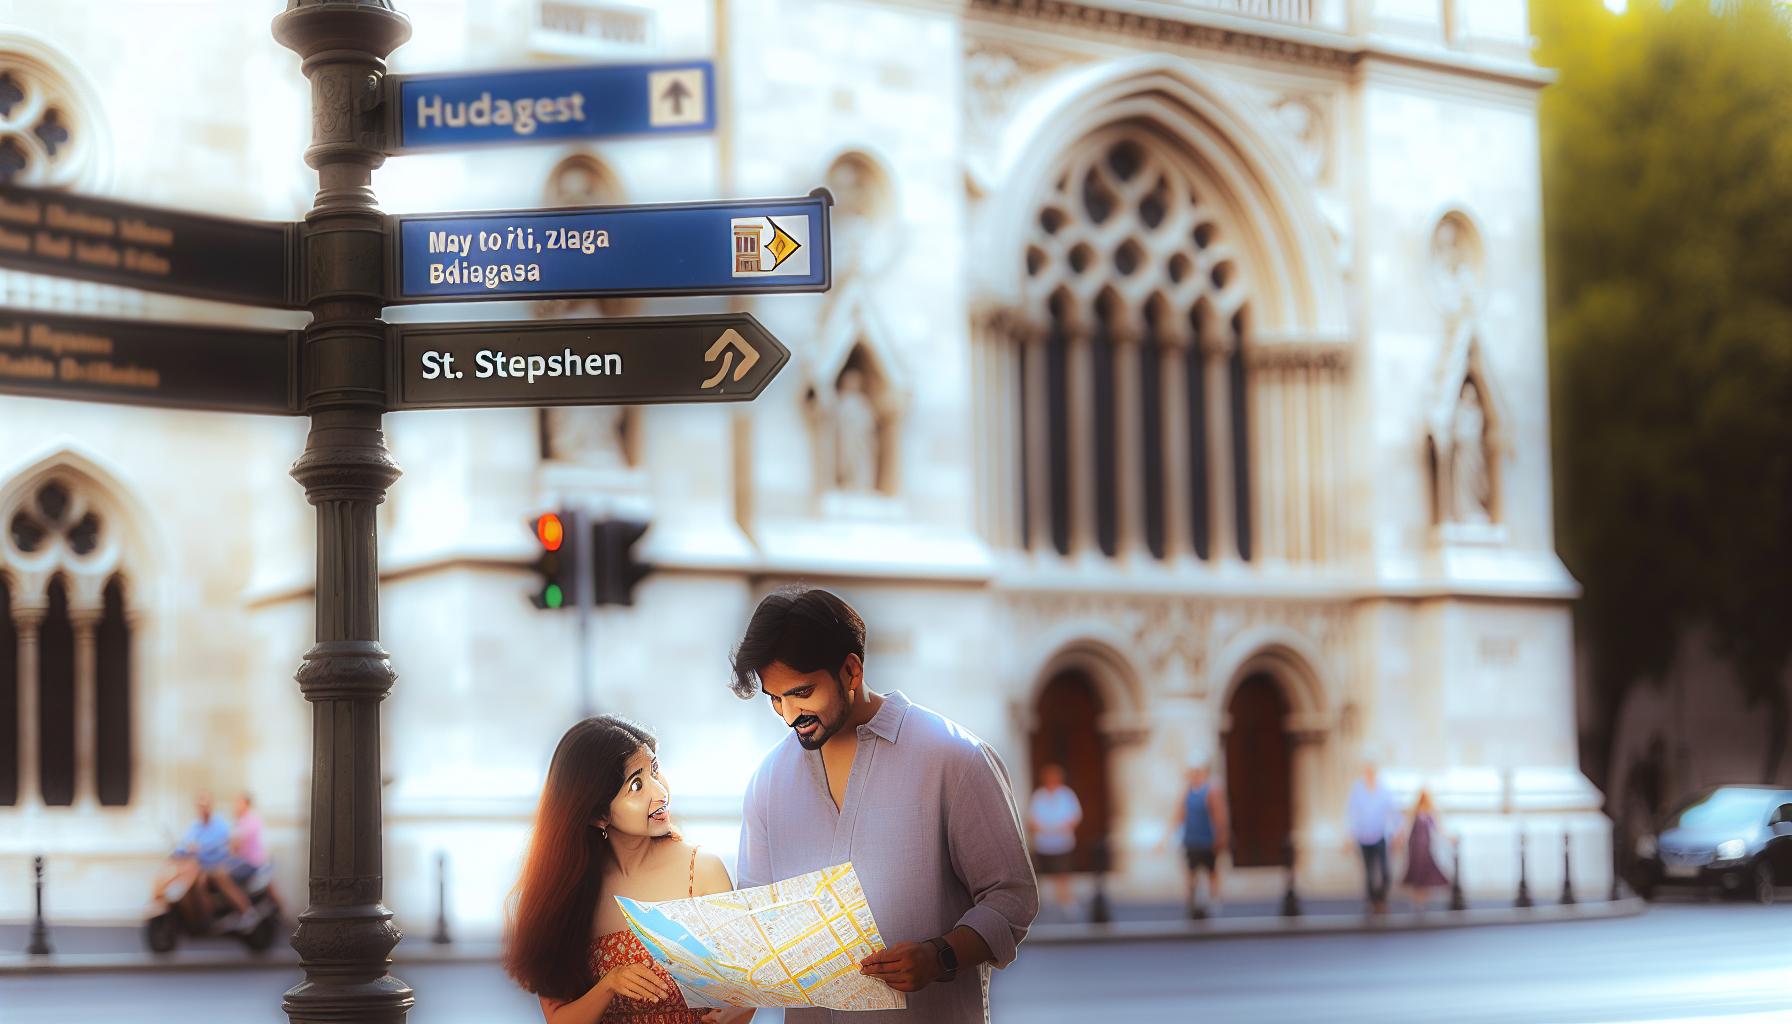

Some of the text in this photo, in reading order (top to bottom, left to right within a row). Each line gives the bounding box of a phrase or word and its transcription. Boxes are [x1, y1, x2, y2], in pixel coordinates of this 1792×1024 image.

[417, 92, 585, 134] Hudagest
[421, 348, 622, 384] St. Stepshen
